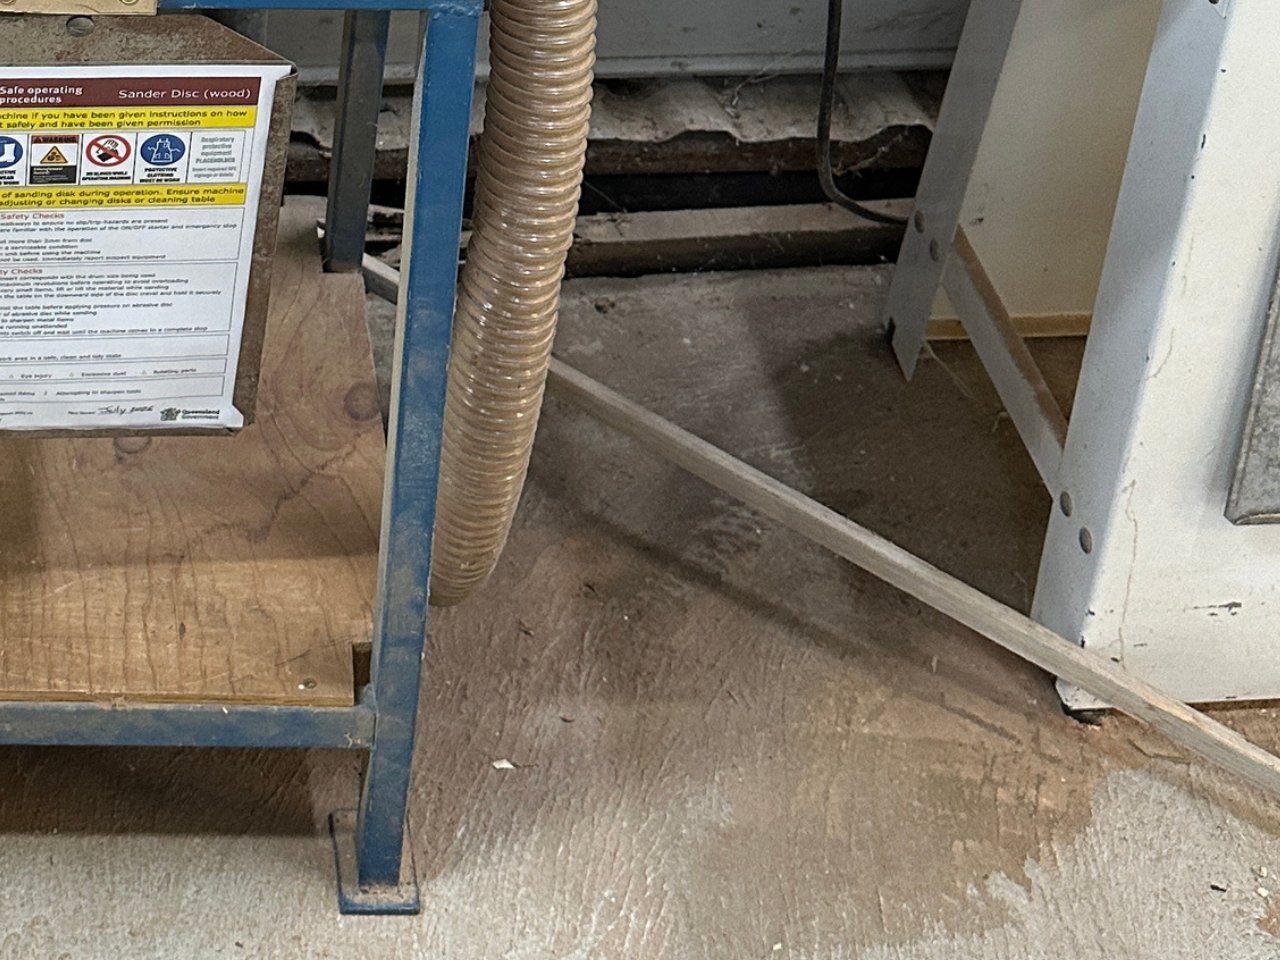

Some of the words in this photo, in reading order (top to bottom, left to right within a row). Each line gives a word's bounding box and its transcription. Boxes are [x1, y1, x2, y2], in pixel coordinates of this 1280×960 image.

[0, 86, 24, 94] Safe
[28, 86, 83, 97] operating
[119, 90, 168, 98] Sander
[204, 89, 251, 99] (wood)
[0, 95, 62, 105] procedures
[119, 111, 146, 120] given
[7, 121, 35, 130] safely
[116, 120, 143, 128] given
[147, 119, 201, 128] permission
[15, 191, 52, 200] sanding
[79, 190, 110, 199] during
[113, 188, 162, 198] operation.
[59, 197, 104, 207] changing
[148, 196, 188, 205] cleaning
[1, 213, 28, 221] Safety
